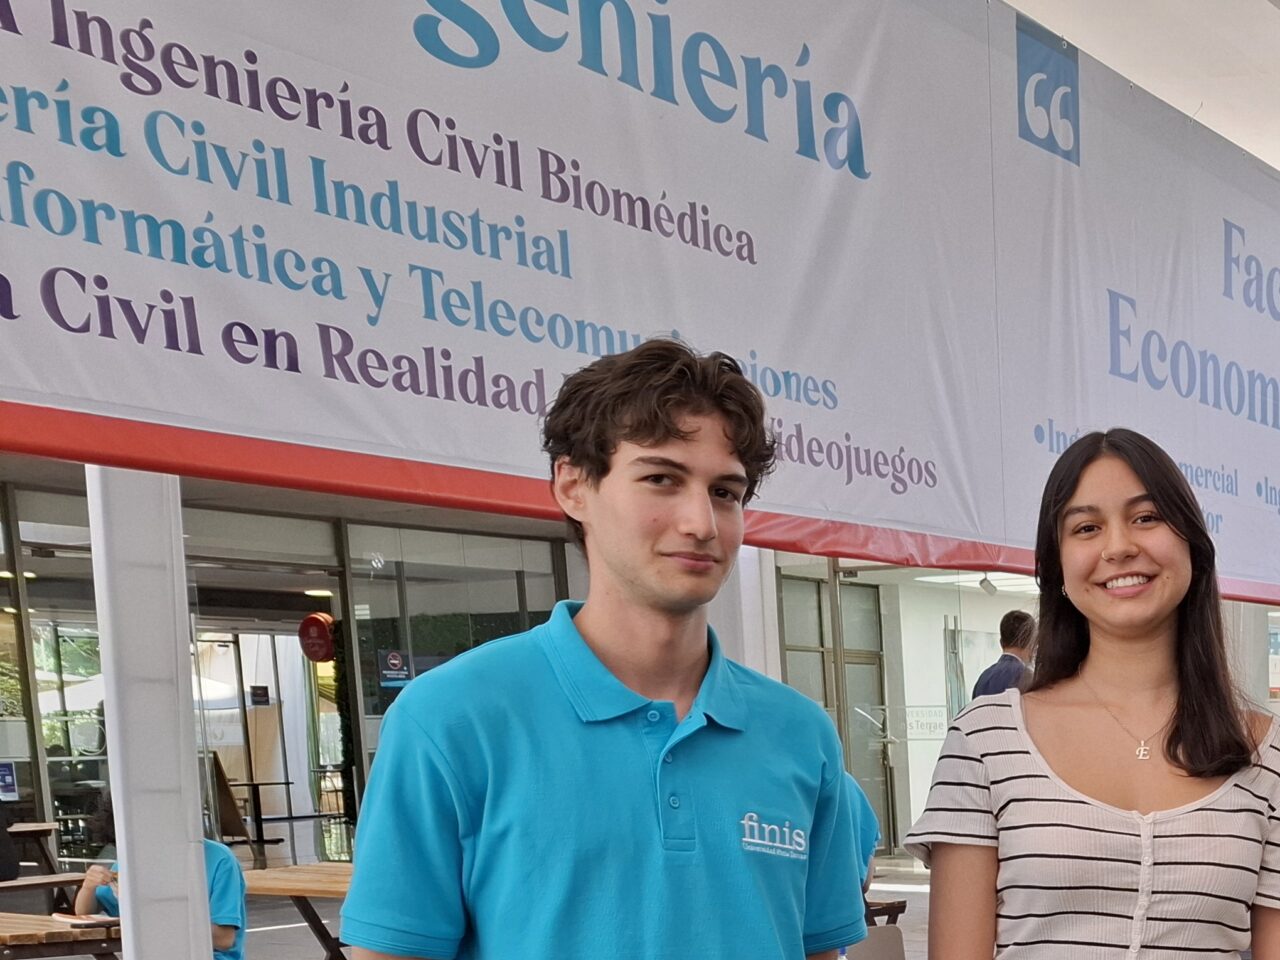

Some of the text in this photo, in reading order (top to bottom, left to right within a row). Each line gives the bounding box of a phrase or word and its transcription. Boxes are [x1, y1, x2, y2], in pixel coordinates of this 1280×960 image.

[50, 0, 757, 265] Ingeniería Civil Biomédica
[143, 110, 292, 205] Civil
[310, 156, 573, 278] Industrial
[0, 160, 347, 300] formática
[358, 266, 391, 327] y
[40, 267, 204, 355] Civil
[221, 320, 300, 373] en
[316, 322, 547, 417] Realidad
[767, 417, 937, 495] ideojuegos
[1178, 461, 1239, 496] mercial
[740, 812, 807, 851] finis
